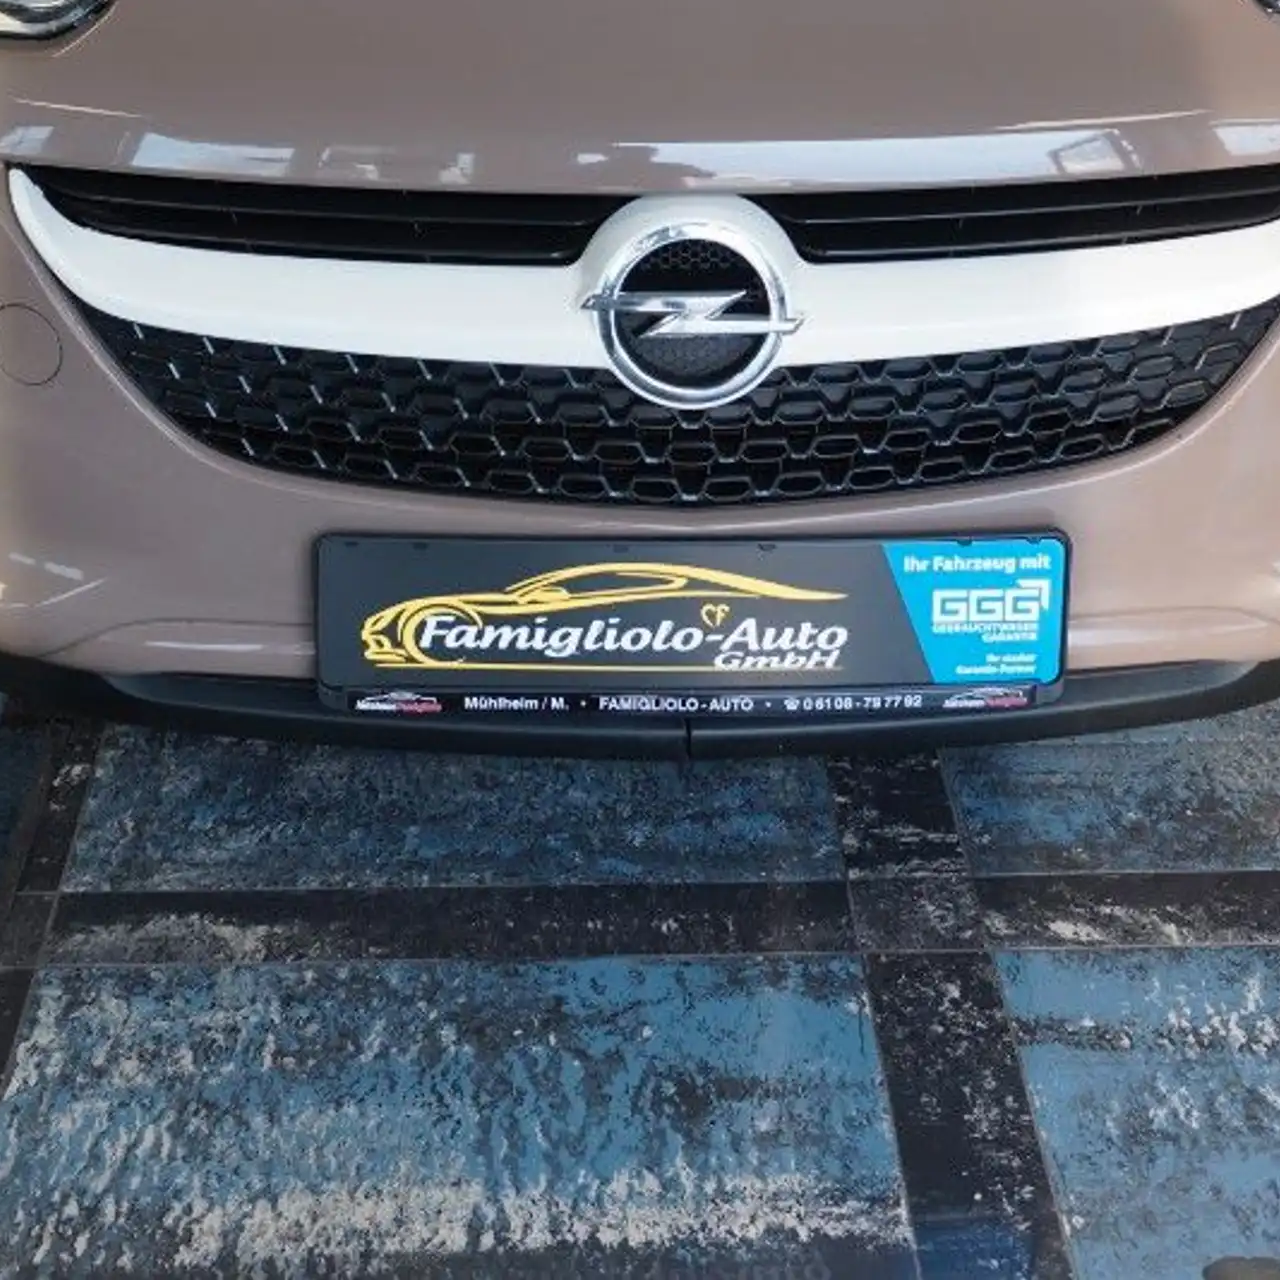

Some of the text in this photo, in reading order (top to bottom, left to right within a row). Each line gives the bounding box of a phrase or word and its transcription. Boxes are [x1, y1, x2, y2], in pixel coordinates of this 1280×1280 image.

[904, 552, 1052, 573] Ihr Fahrzeug mit
[932, 588, 1041, 622] GGG
[420, 615, 848, 658] Famigliolo-Auto
[713, 650, 840, 671] GmbH
[464, 696, 538, 710] Mühlheim
